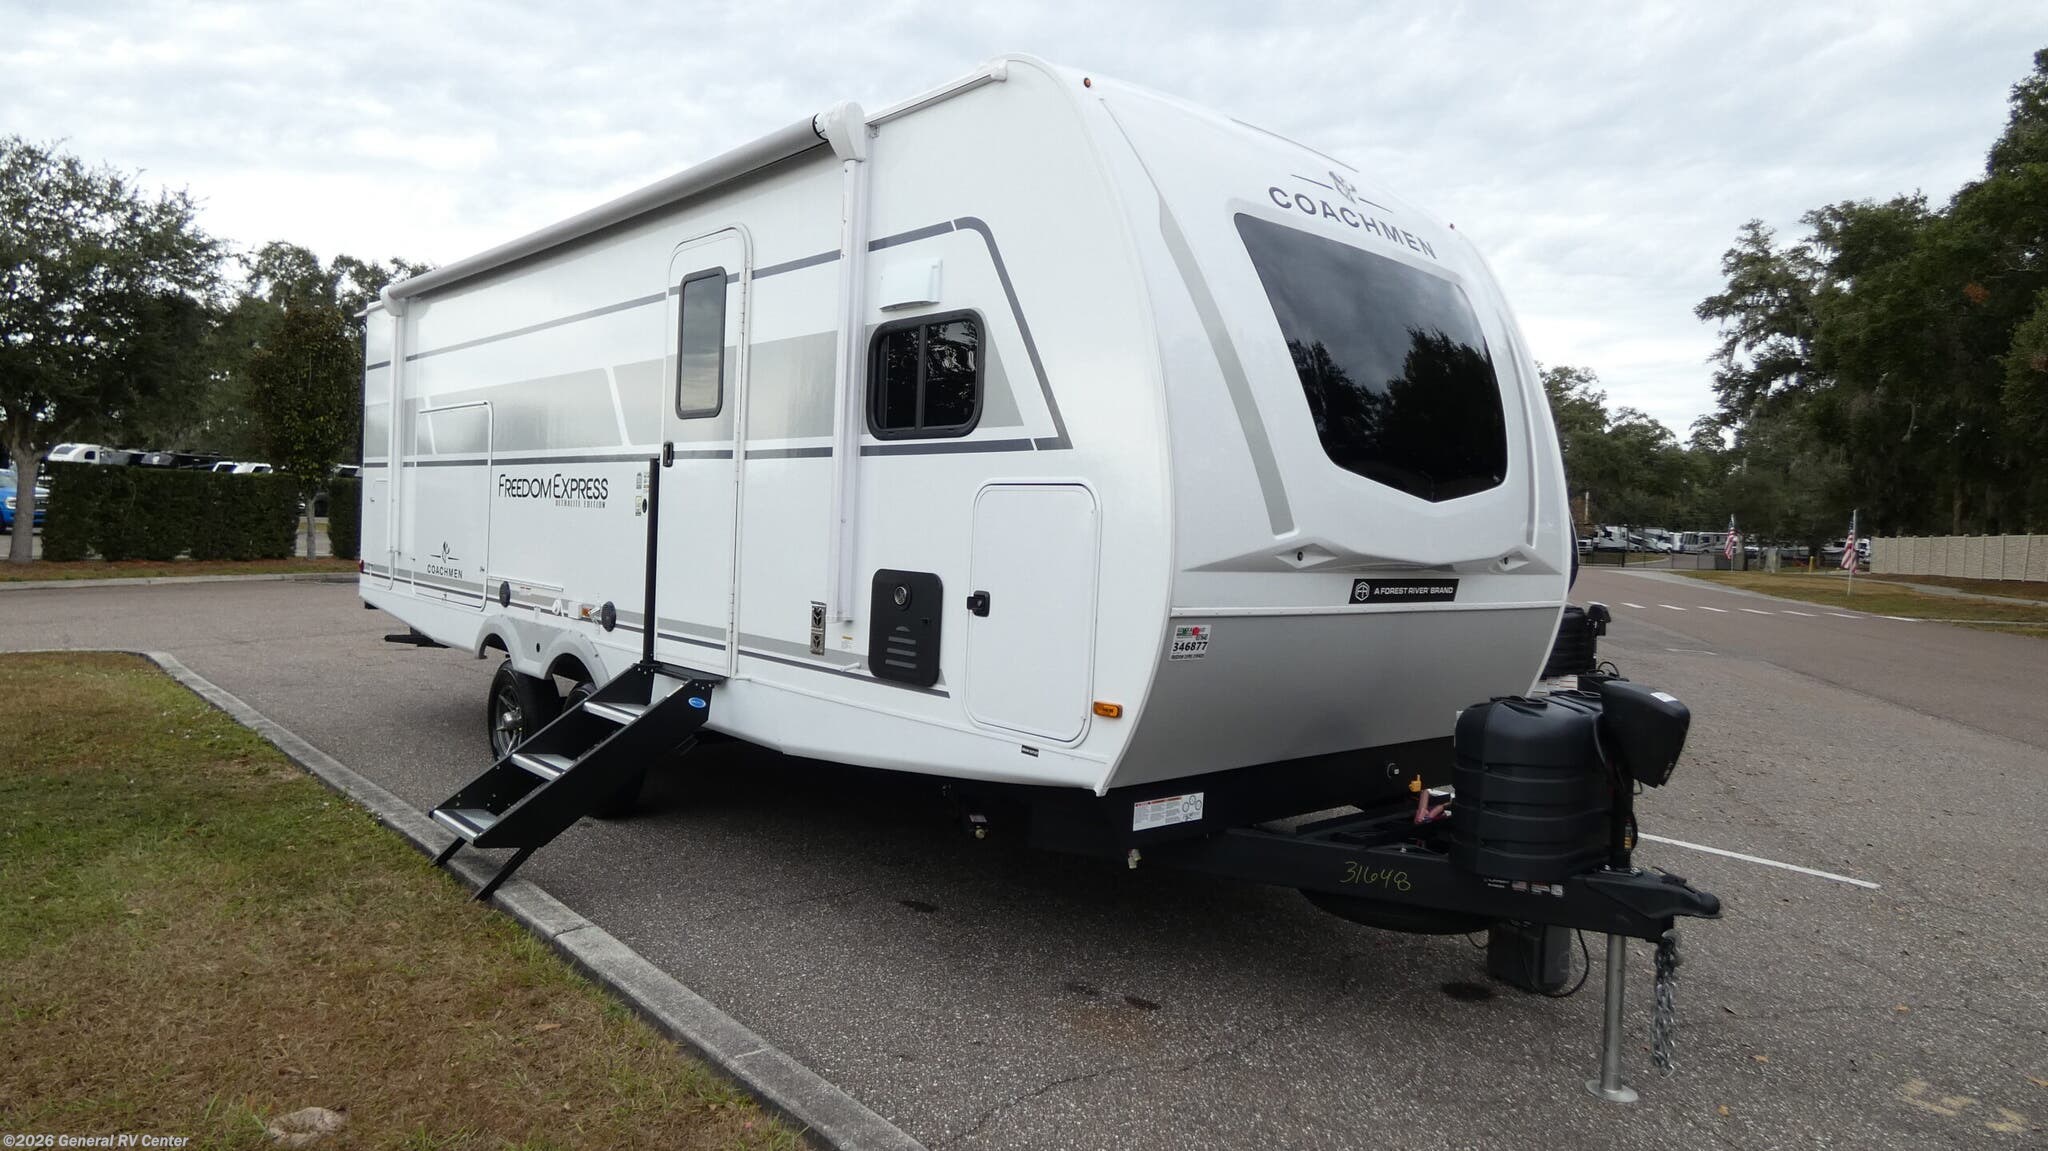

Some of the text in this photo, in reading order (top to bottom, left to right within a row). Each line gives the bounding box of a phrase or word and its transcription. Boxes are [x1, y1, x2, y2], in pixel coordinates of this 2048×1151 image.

[1268, 187, 1437, 259] COACHMEN
[427, 564, 463, 579] COACHMEN
[1380, 587, 1408, 595] FOREST
[1430, 586, 1454, 594] BRAND
[1172, 641, 1208, 652] 346877
[1339, 861, 1411, 891] 31648
